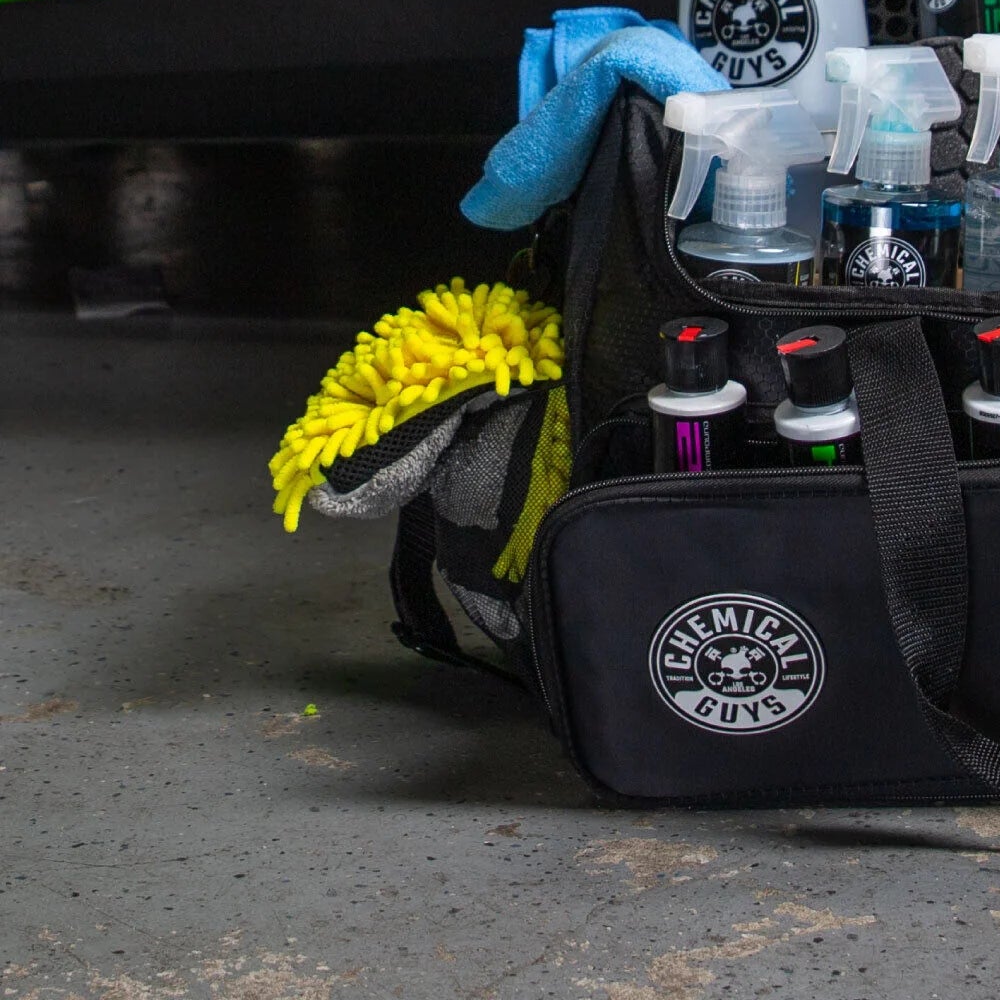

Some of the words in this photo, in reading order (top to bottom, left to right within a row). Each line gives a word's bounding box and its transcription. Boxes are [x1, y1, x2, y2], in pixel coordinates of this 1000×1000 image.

[712, 47, 787, 80] GUYS
[851, 243, 920, 282] CHEMICAL
[664, 606, 808, 671] CHEMICAL
[694, 695, 787, 723] GUYS
